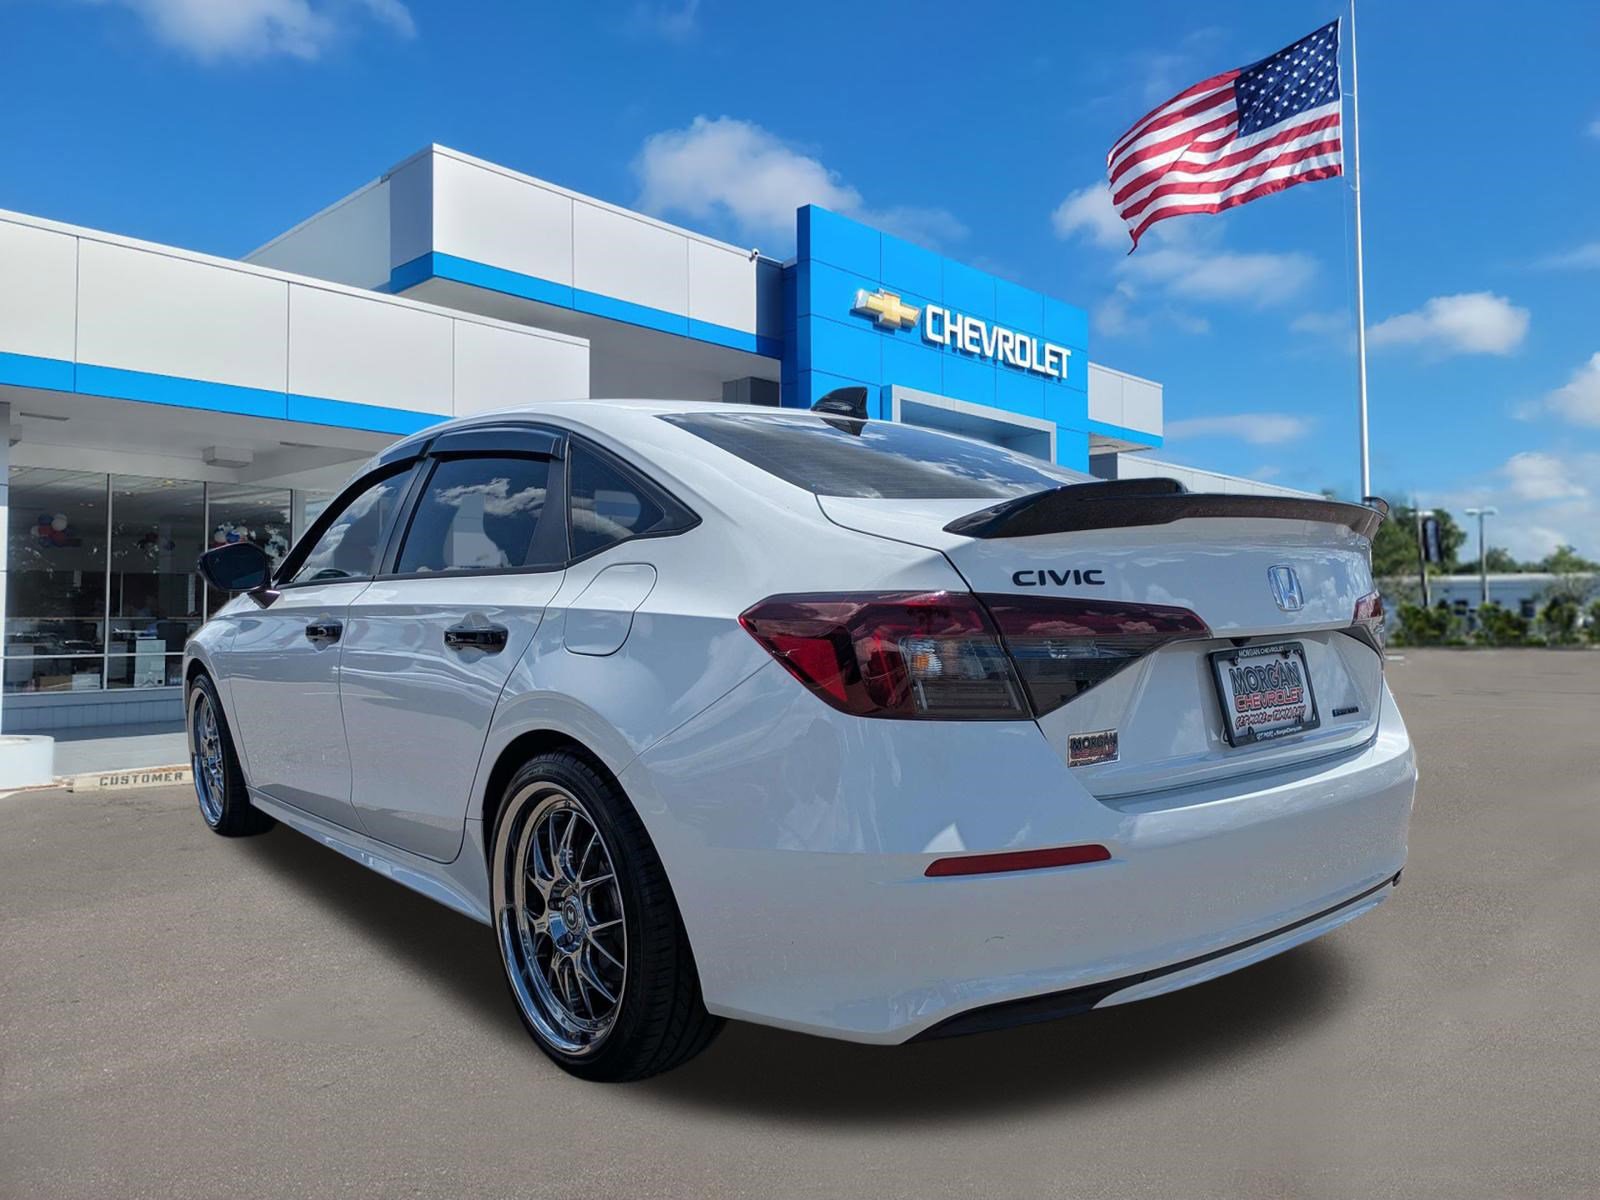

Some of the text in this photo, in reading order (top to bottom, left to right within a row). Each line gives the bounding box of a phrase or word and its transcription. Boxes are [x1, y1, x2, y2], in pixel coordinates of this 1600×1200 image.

[925, 303, 1072, 379] CHEVROLET
[1012, 569, 1105, 586] CIVIC
[1229, 660, 1304, 696] MORGAN
[1234, 687, 1304, 713] CHEVROLET
[100, 772, 183, 786] CUSTOMER
